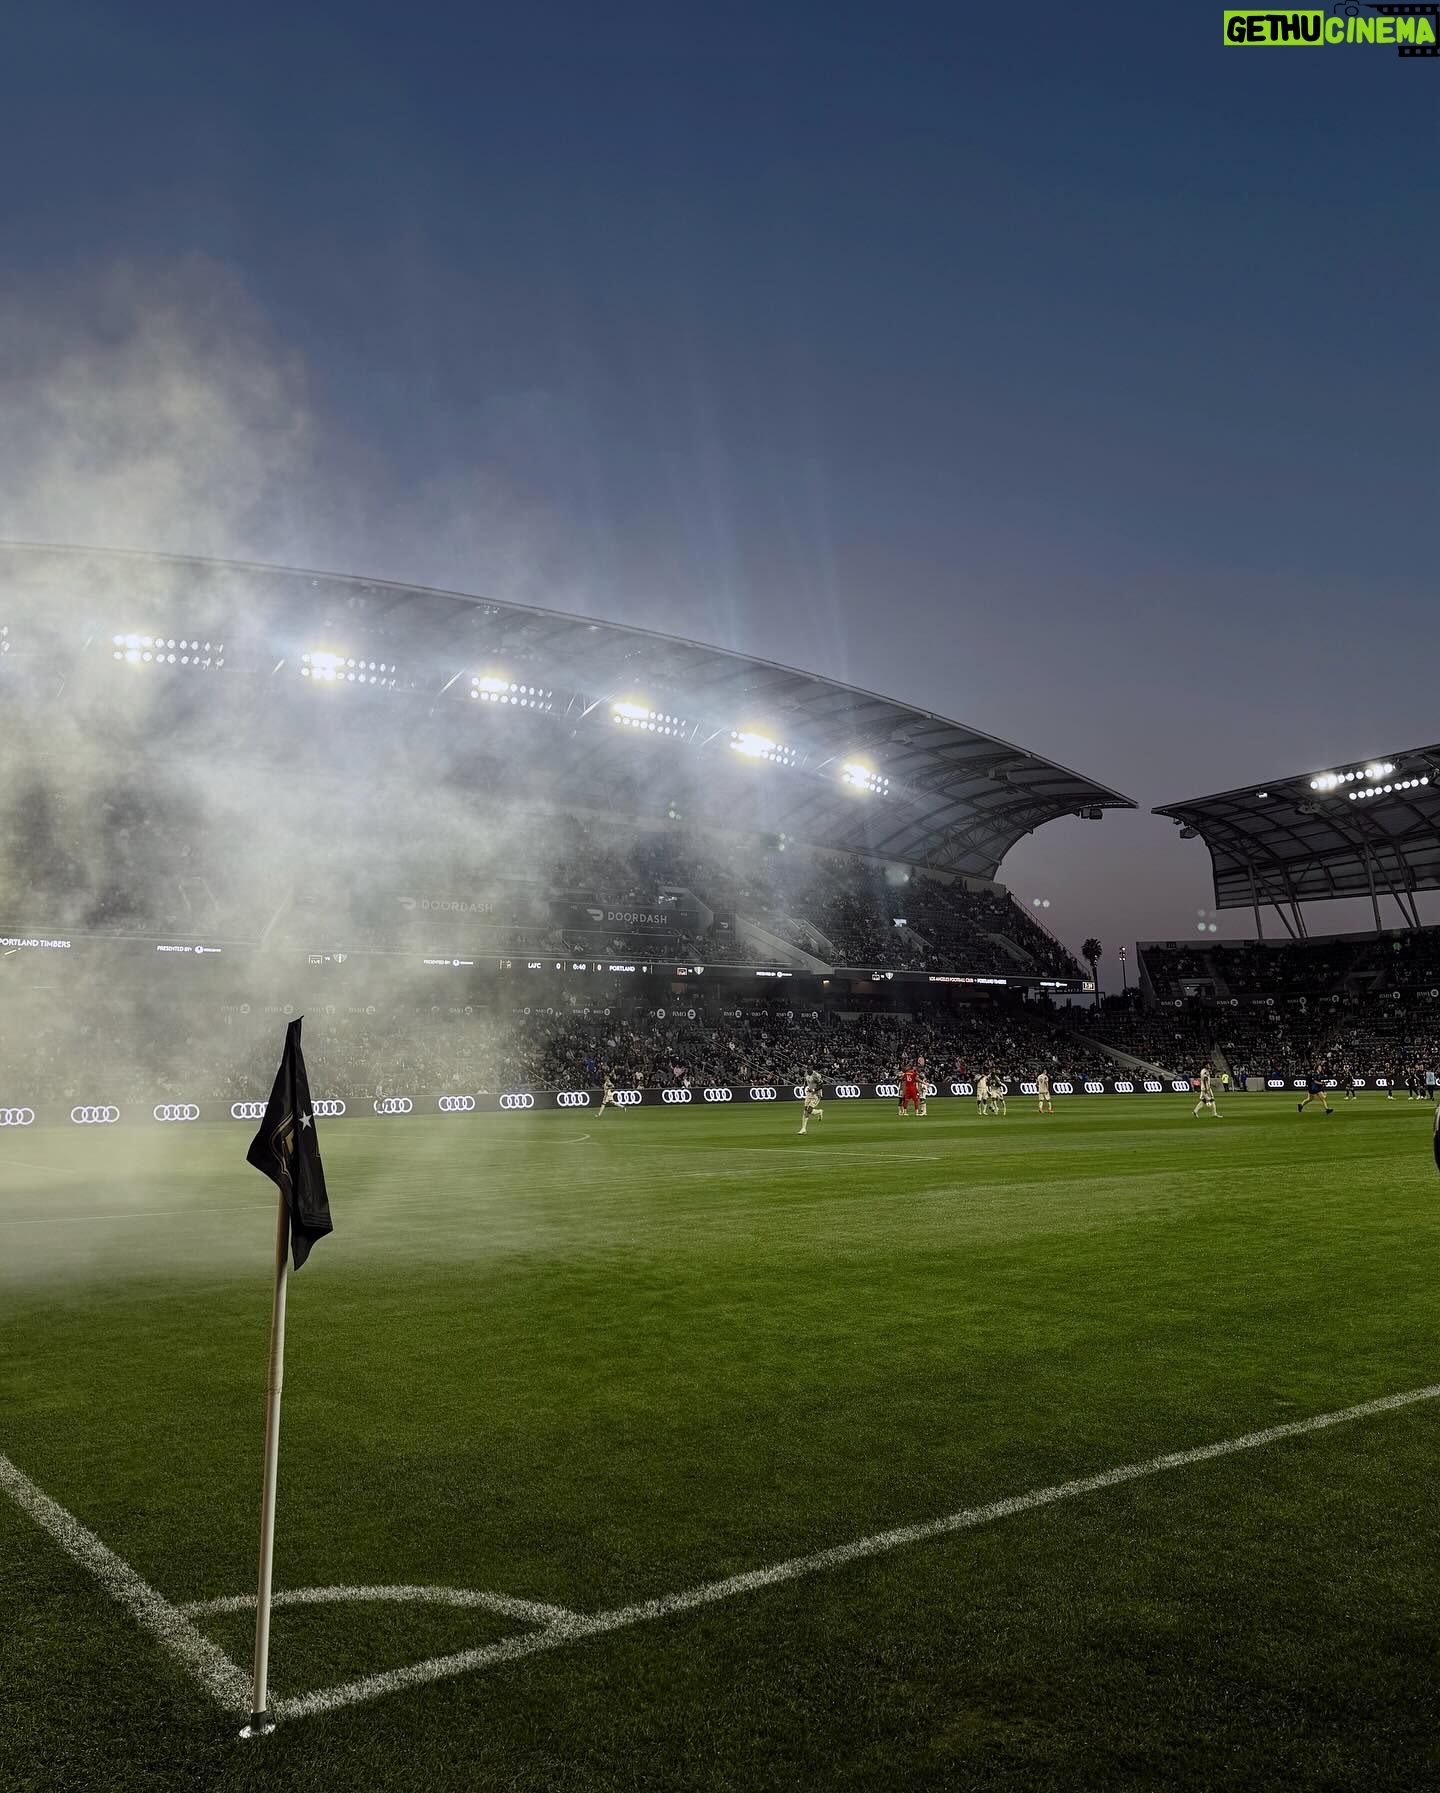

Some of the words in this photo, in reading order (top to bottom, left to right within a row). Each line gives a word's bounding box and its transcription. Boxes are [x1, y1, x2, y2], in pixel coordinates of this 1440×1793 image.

[422, 900, 493, 913] DOORDASH
[608, 912, 667, 924] DOORDASH
[40, 940, 72, 949] TIMBERS
